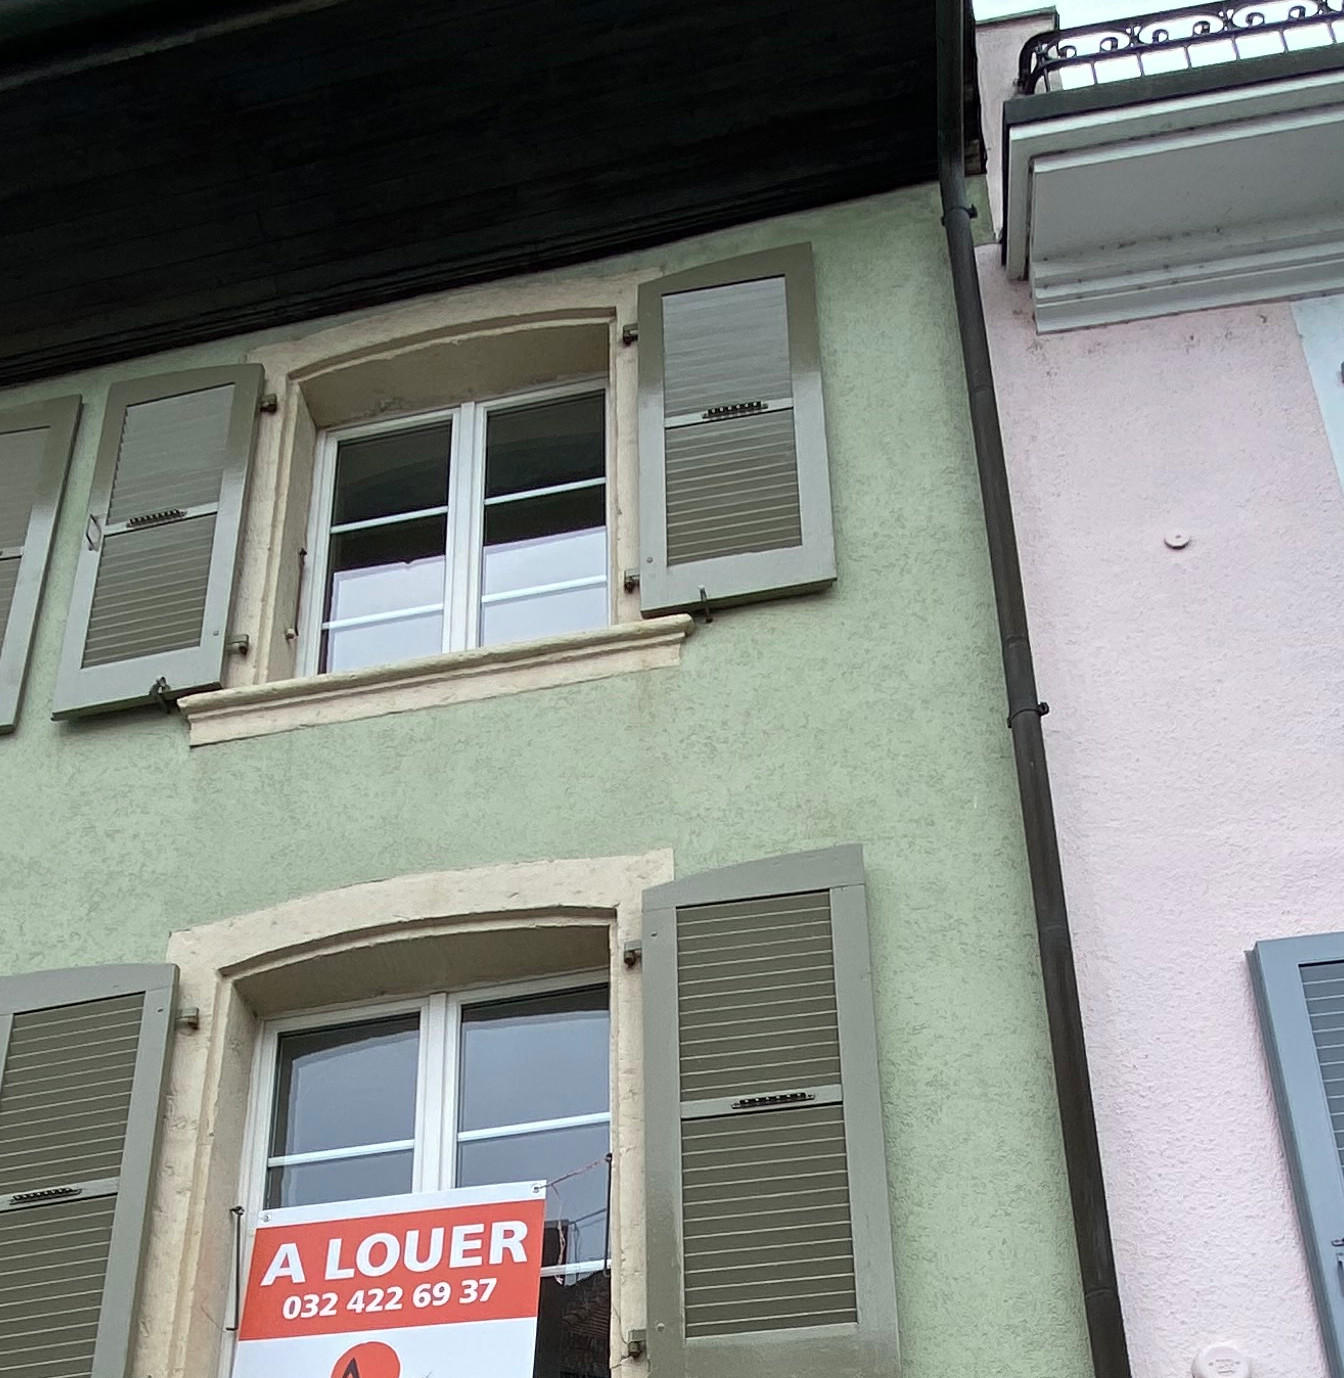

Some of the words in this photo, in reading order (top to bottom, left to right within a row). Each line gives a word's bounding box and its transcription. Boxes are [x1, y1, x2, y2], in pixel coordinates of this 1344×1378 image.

[260, 1242, 306, 1286] A
[325, 1220, 528, 1281] LOUER
[282, 1292, 339, 1320] 032
[346, 1286, 403, 1314] 422
[412, 1281, 452, 1308] 69
[459, 1278, 498, 1304] 37
